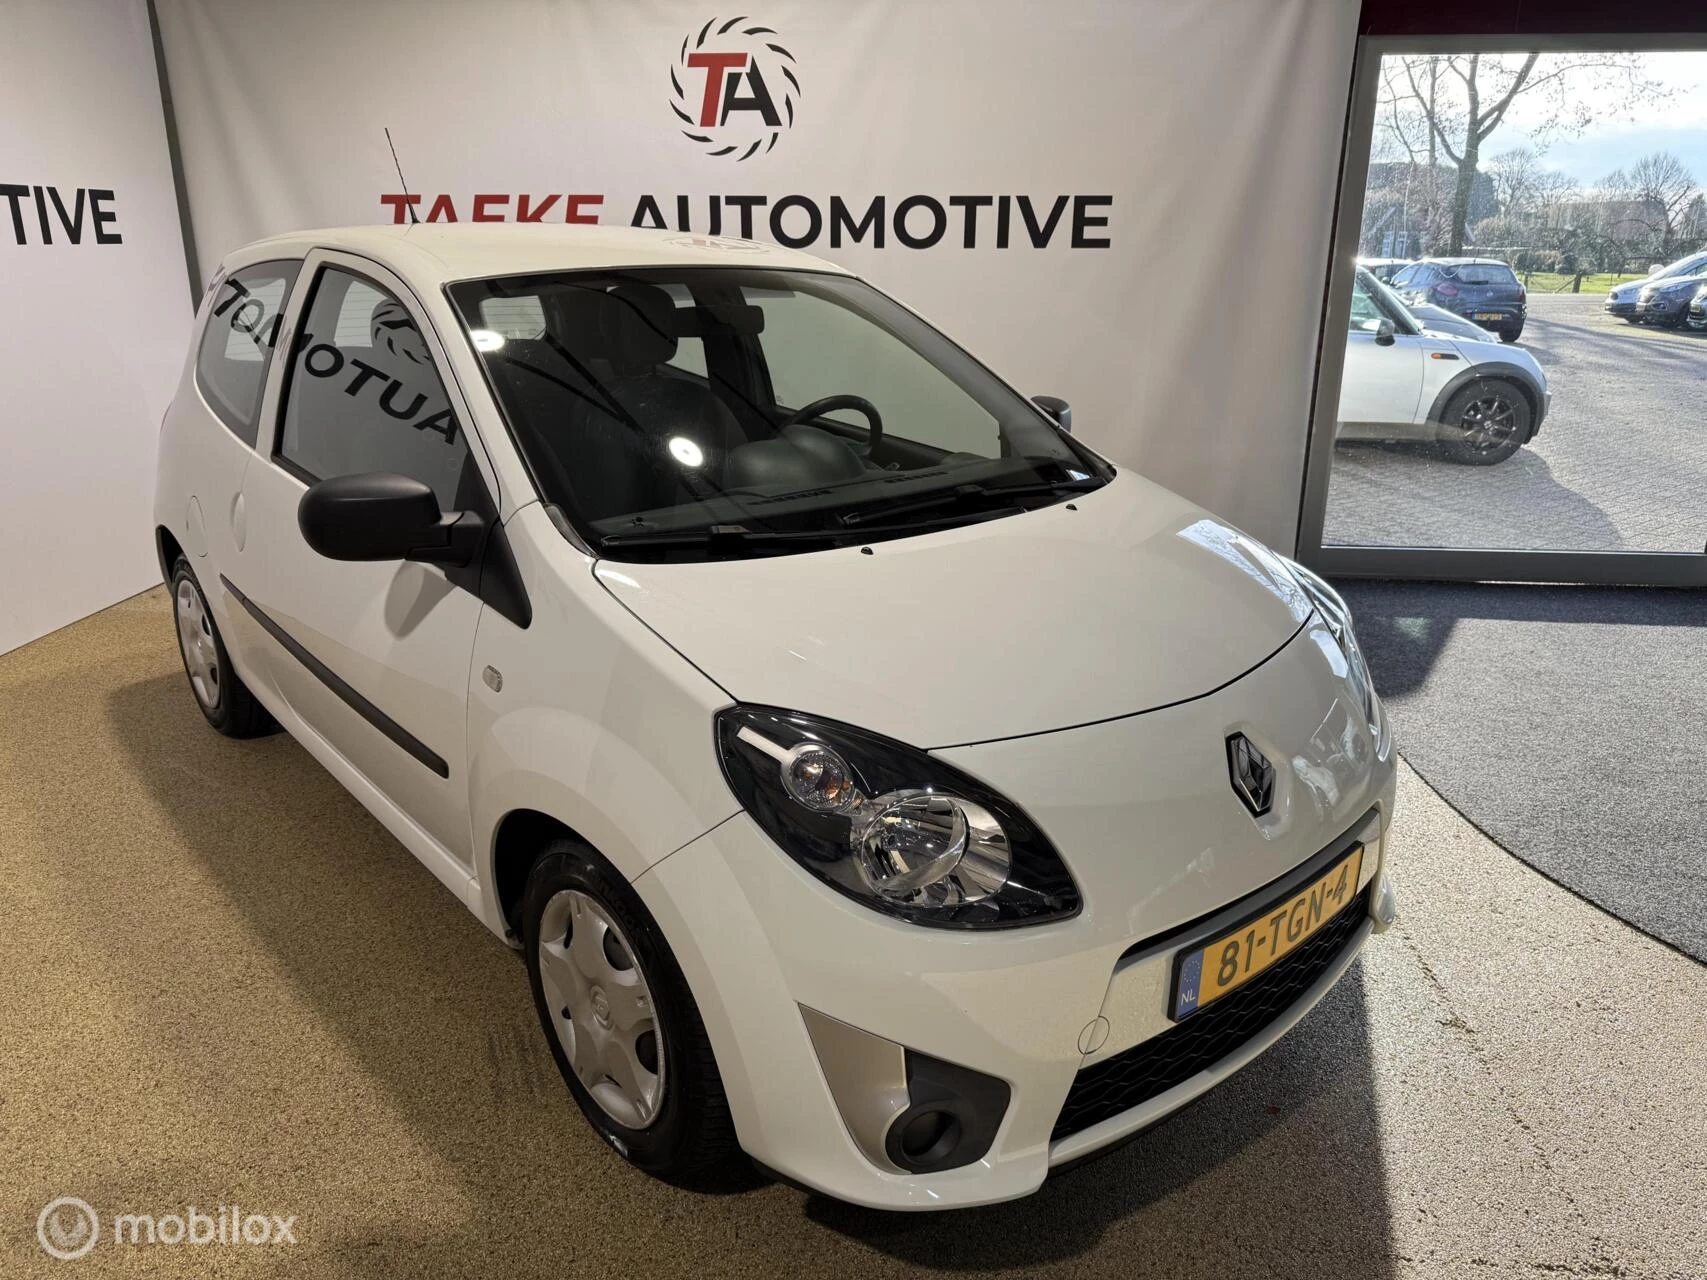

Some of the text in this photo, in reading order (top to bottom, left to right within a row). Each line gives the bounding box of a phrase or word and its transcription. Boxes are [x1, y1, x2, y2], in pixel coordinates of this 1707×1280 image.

[687, 52, 783, 127] TA
[0, 183, 123, 245] TIVE
[630, 194, 1113, 249] AUTOMOTIVE
[1217, 864, 1349, 987] 81-TGN-4
[1180, 989, 1196, 1006] NL
